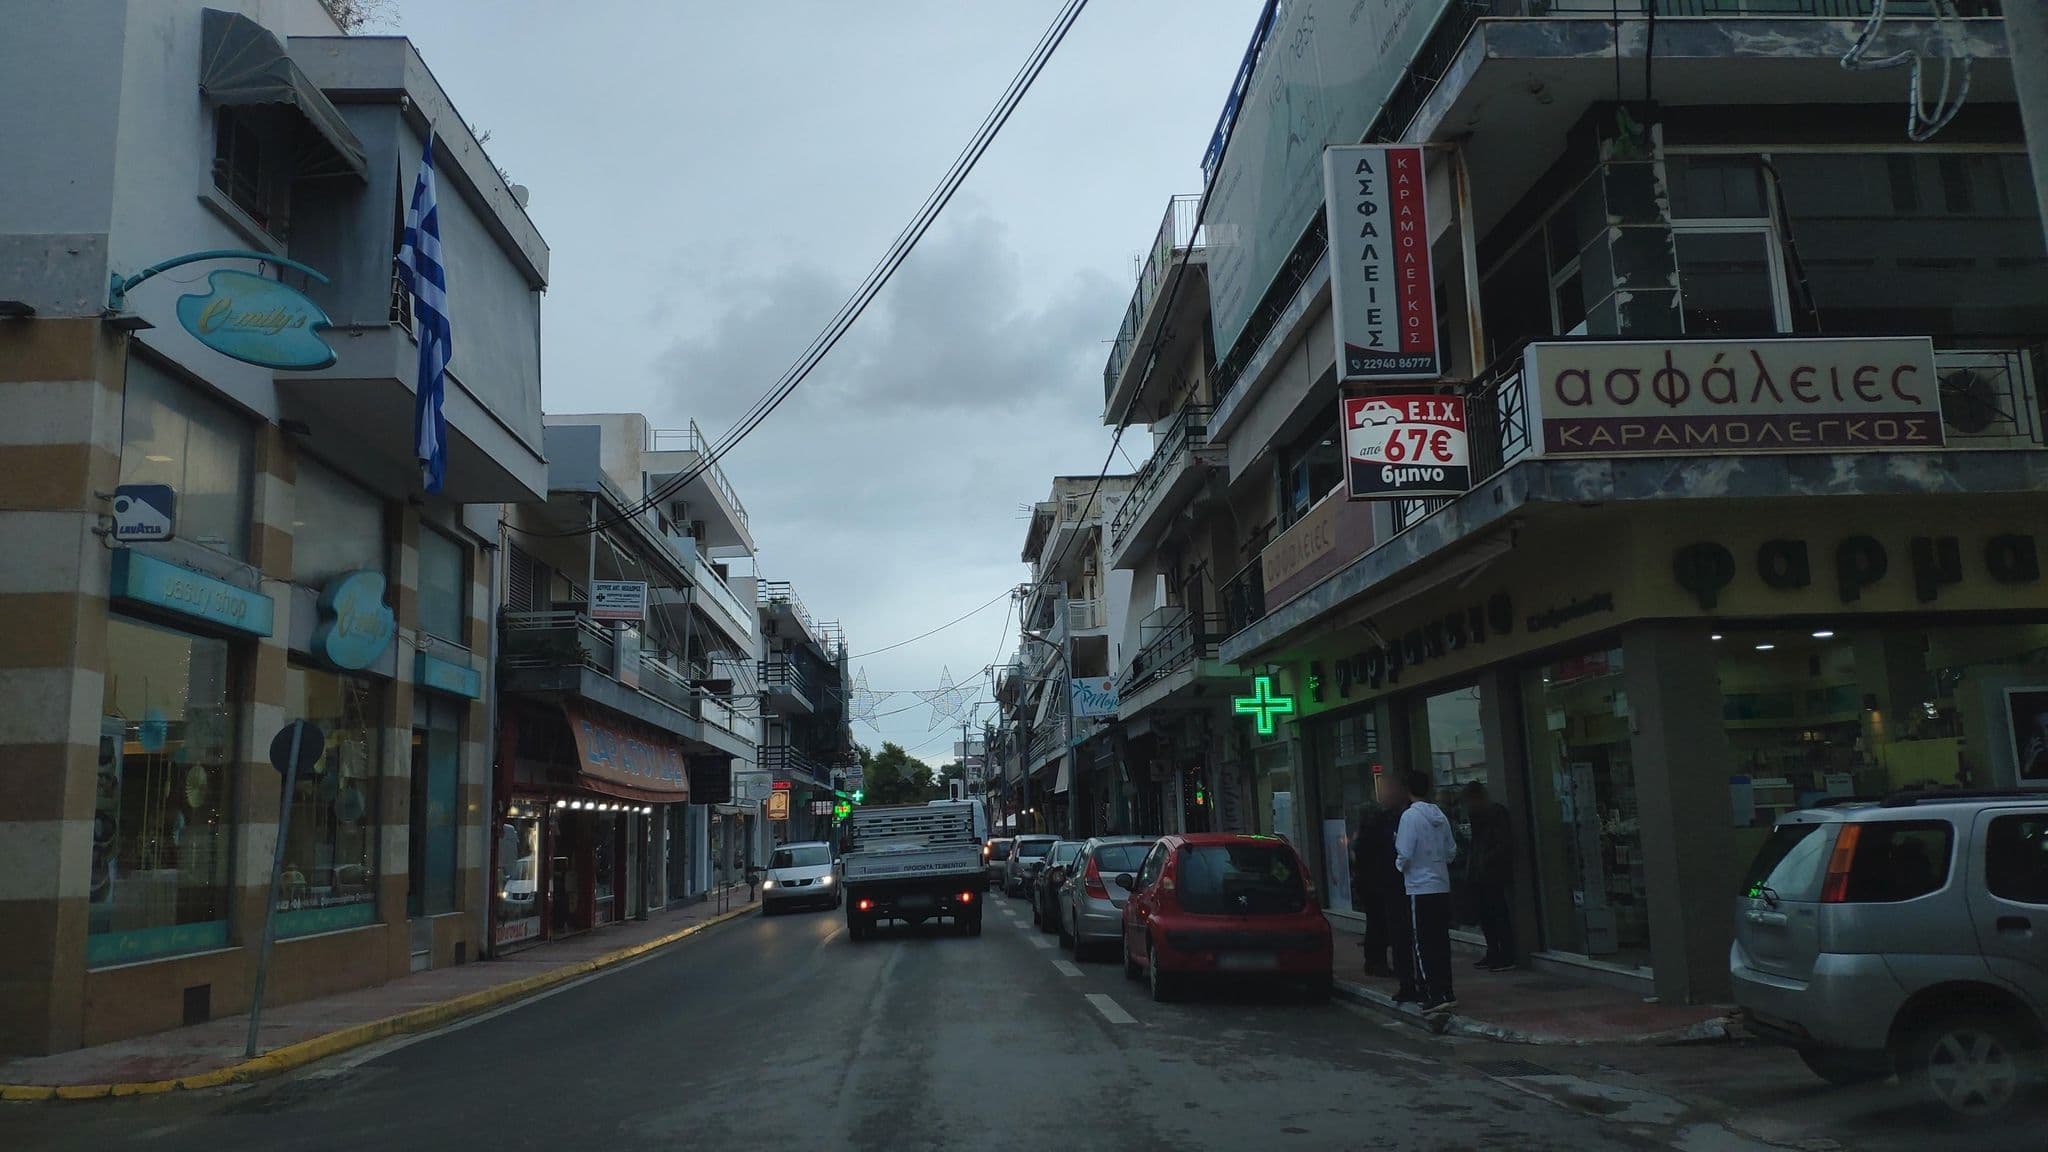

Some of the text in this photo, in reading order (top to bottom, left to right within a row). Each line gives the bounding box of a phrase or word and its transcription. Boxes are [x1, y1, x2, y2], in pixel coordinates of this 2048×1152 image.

[1355, 158, 1384, 347] ΑΣΦΑΛΕΙΕΣ
[1397, 158, 1421, 344] ΚΑΡΑΜΟΛΕΓΚΟΣ
[1363, 358, 1432, 369] 22940 86777
[1555, 349, 1922, 408] ασφάλειες
[1408, 401, 1460, 422] Ε.Ι.Χ.
[1360, 429, 1454, 462] από 67€
[1559, 419, 1930, 447] ΚΑΡΑΜΟΛΕΓΚΟΣ
[1381, 464, 1445, 488] 6μηνο
[119, 523, 162, 534] LAVAZZA
[216, 586, 248, 623] shop
